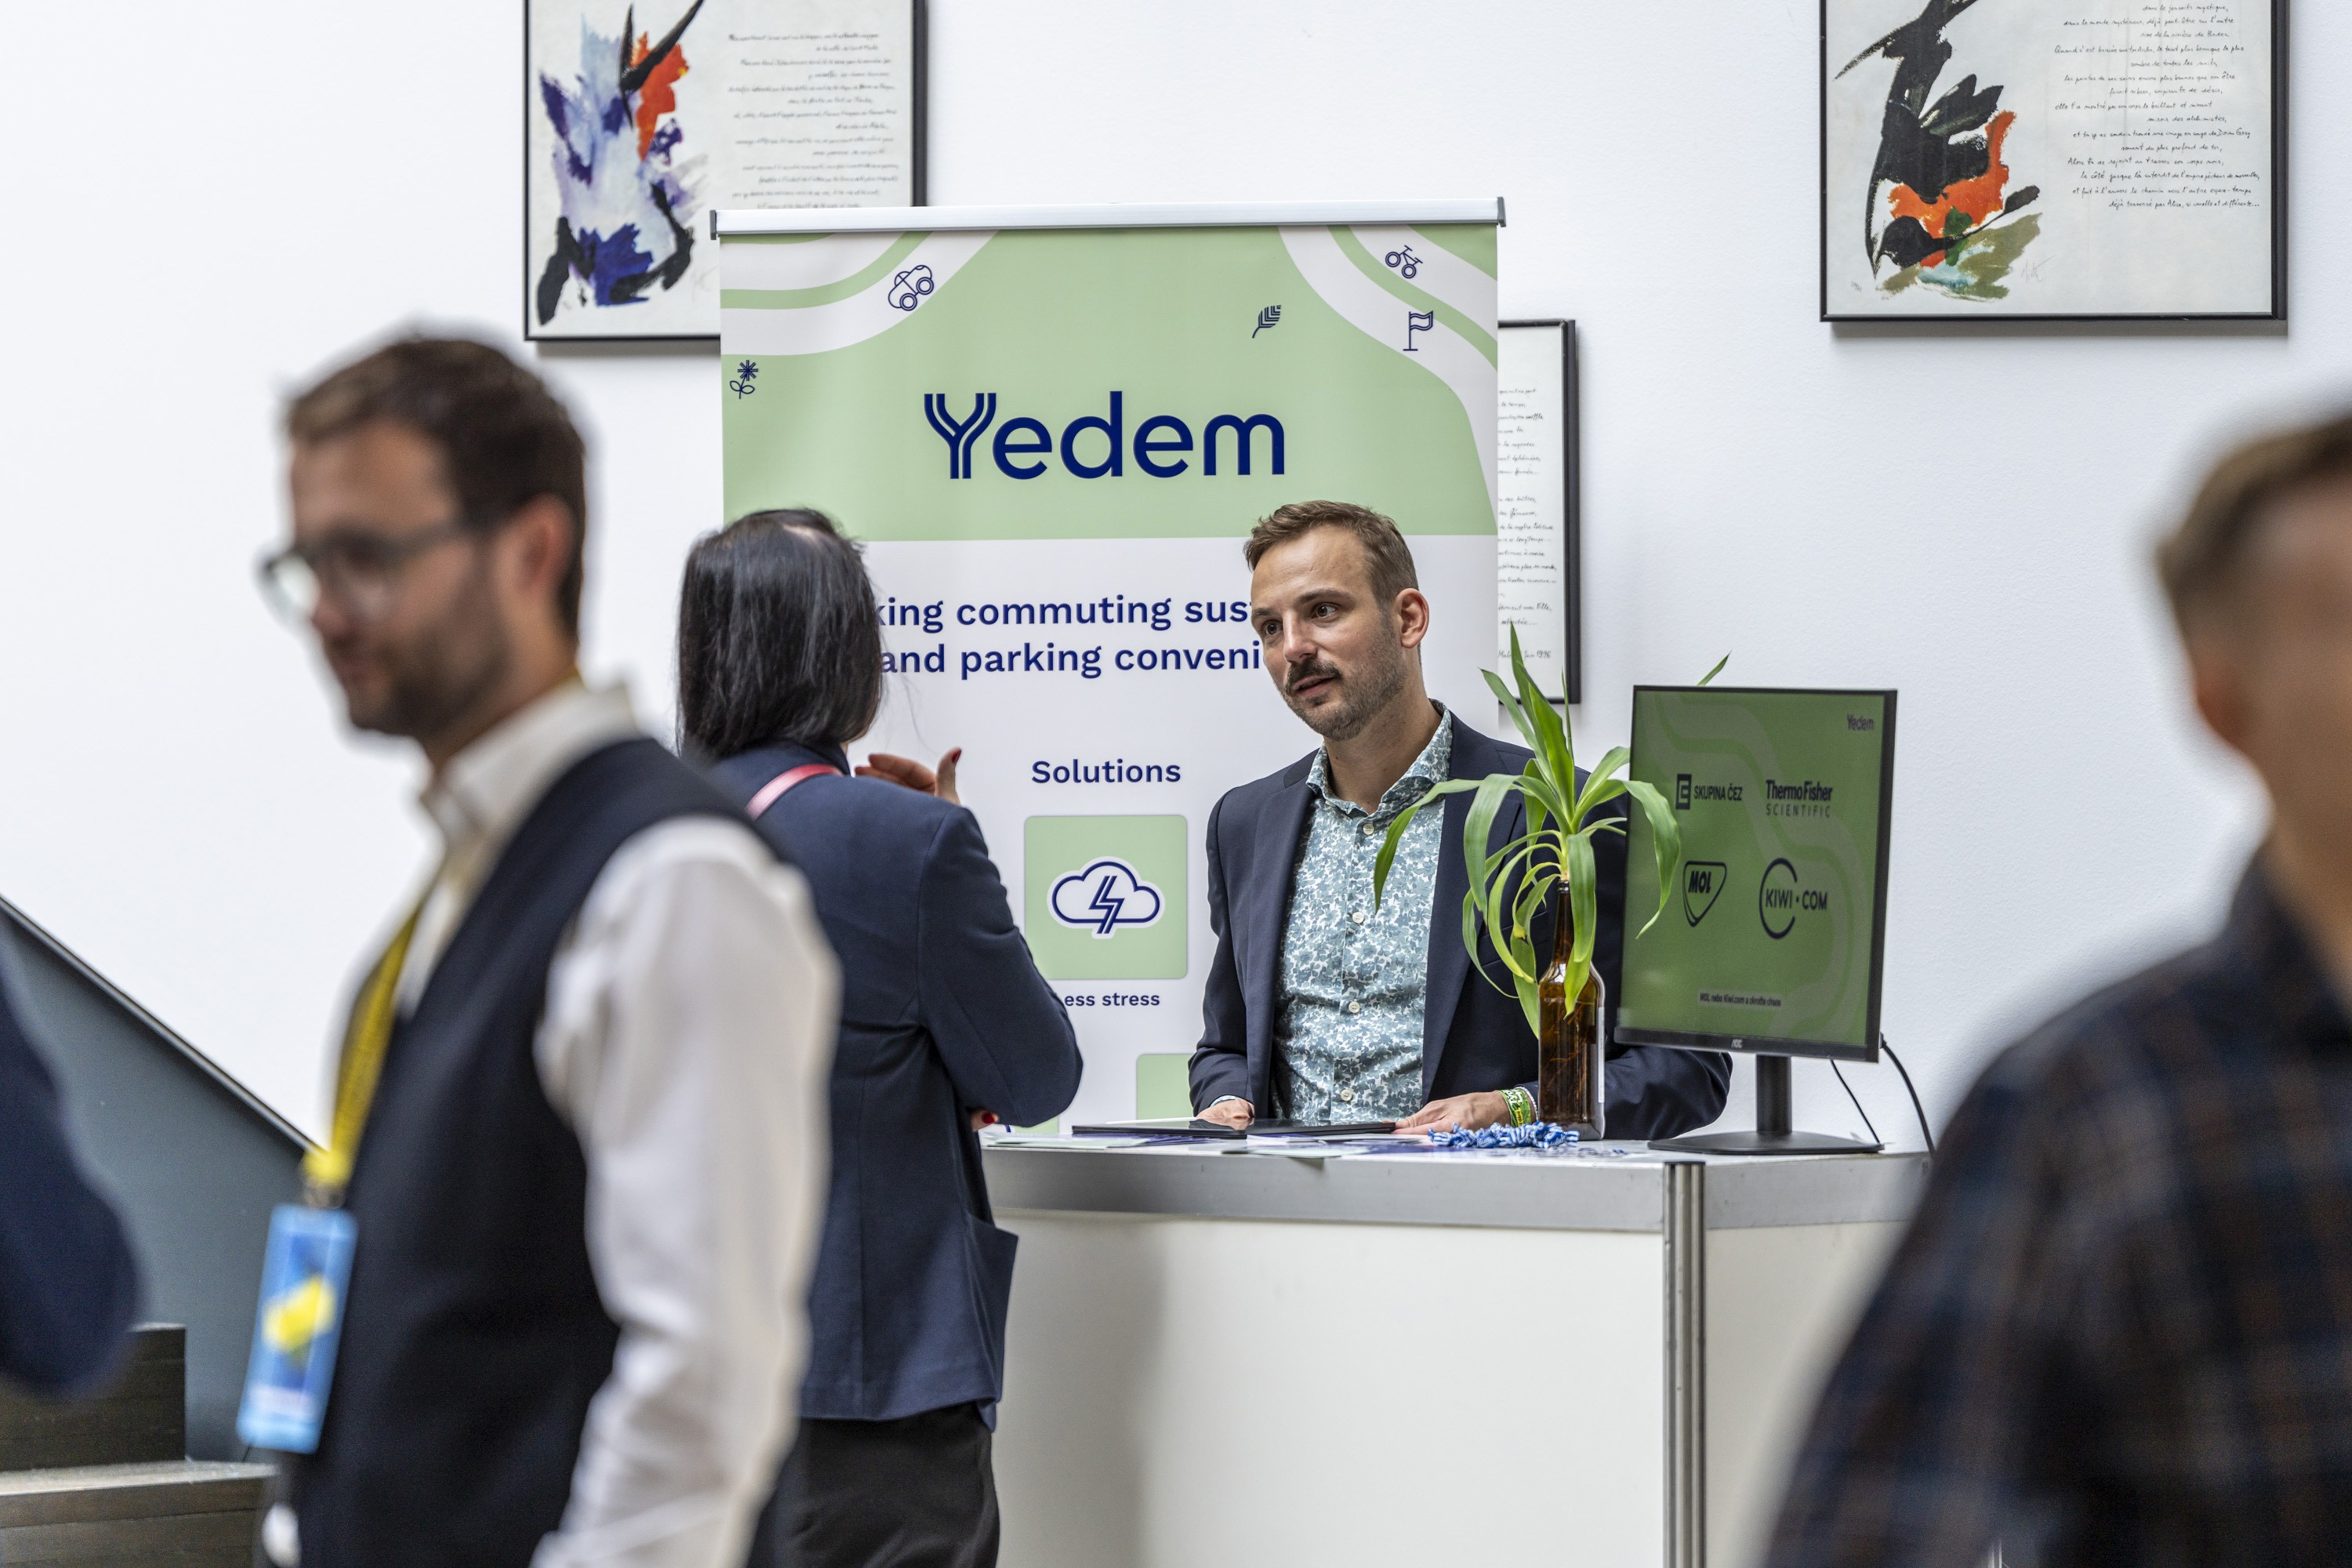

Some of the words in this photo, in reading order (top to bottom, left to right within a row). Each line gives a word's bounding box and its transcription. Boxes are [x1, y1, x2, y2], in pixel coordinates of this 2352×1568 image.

[2054, 45, 2078, 53] Quand
[2230, 45, 2245, 53] plus
[2159, 74, 2173, 83] plus
[2221, 71, 2236, 80] être
[2235, 127, 2252, 140] Gray
[2155, 143, 2169, 153] plus
[2172, 142, 2197, 154] profond
[2067, 156, 2085, 165] Alors
[2090, 169, 2105, 179] côté
[2108, 198, 2124, 211] déjà
[924, 391, 1285, 479] Yedem
[956, 593, 1172, 631] commuting
[1185, 601, 1252, 623] sus
[880, 643, 946, 673] and
[961, 641, 1102, 681] parking
[1032, 758, 1182, 784] Solutions
[1693, 785, 1726, 800] SKUPINA
[1727, 782, 1743, 801] ČEZ
[1766, 803, 1831, 818] SCIENTIFIC
[1688, 870, 1712, 894] MOL
[1064, 994, 1095, 1007] ess
[1102, 992, 1160, 1007] stress
